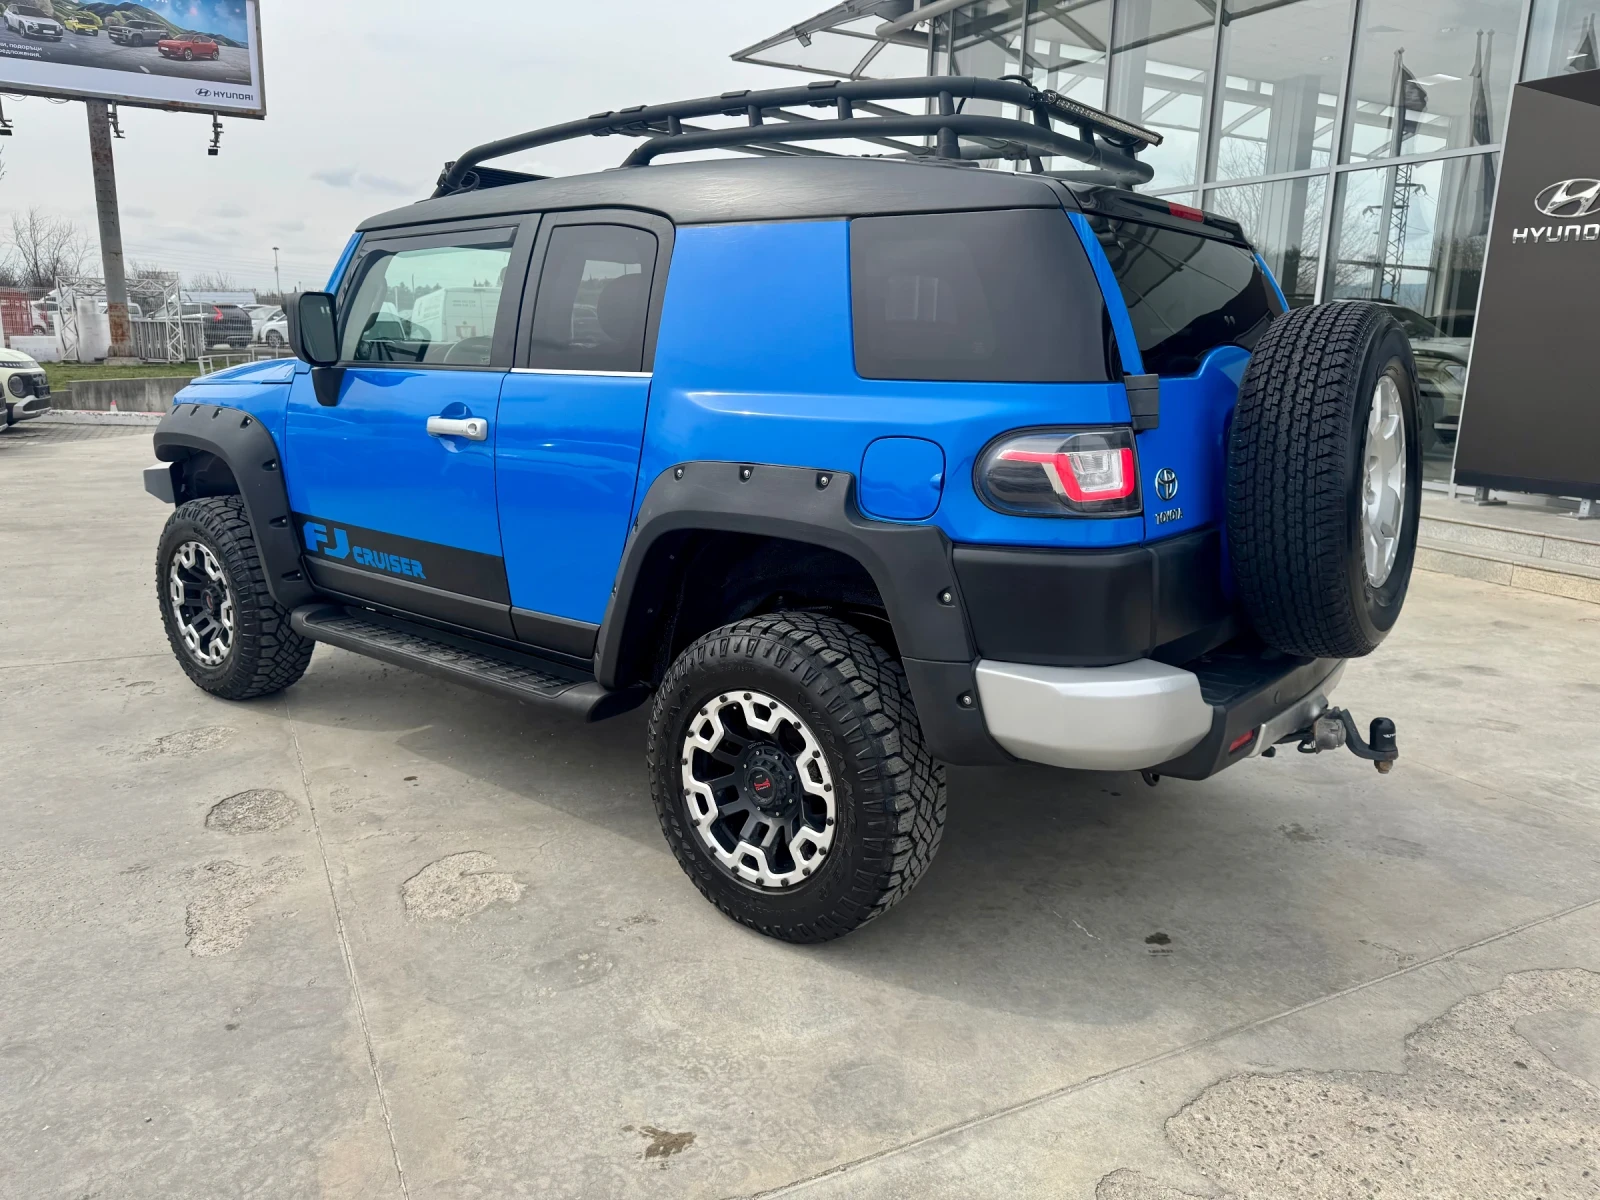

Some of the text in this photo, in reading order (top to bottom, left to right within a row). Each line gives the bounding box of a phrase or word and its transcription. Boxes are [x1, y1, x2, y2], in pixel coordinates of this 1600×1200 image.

[213, 90, 254, 101] HYUNDAI
[1154, 507, 1183, 525] TOYOTA
[303, 521, 427, 579] FJ CRUISER
